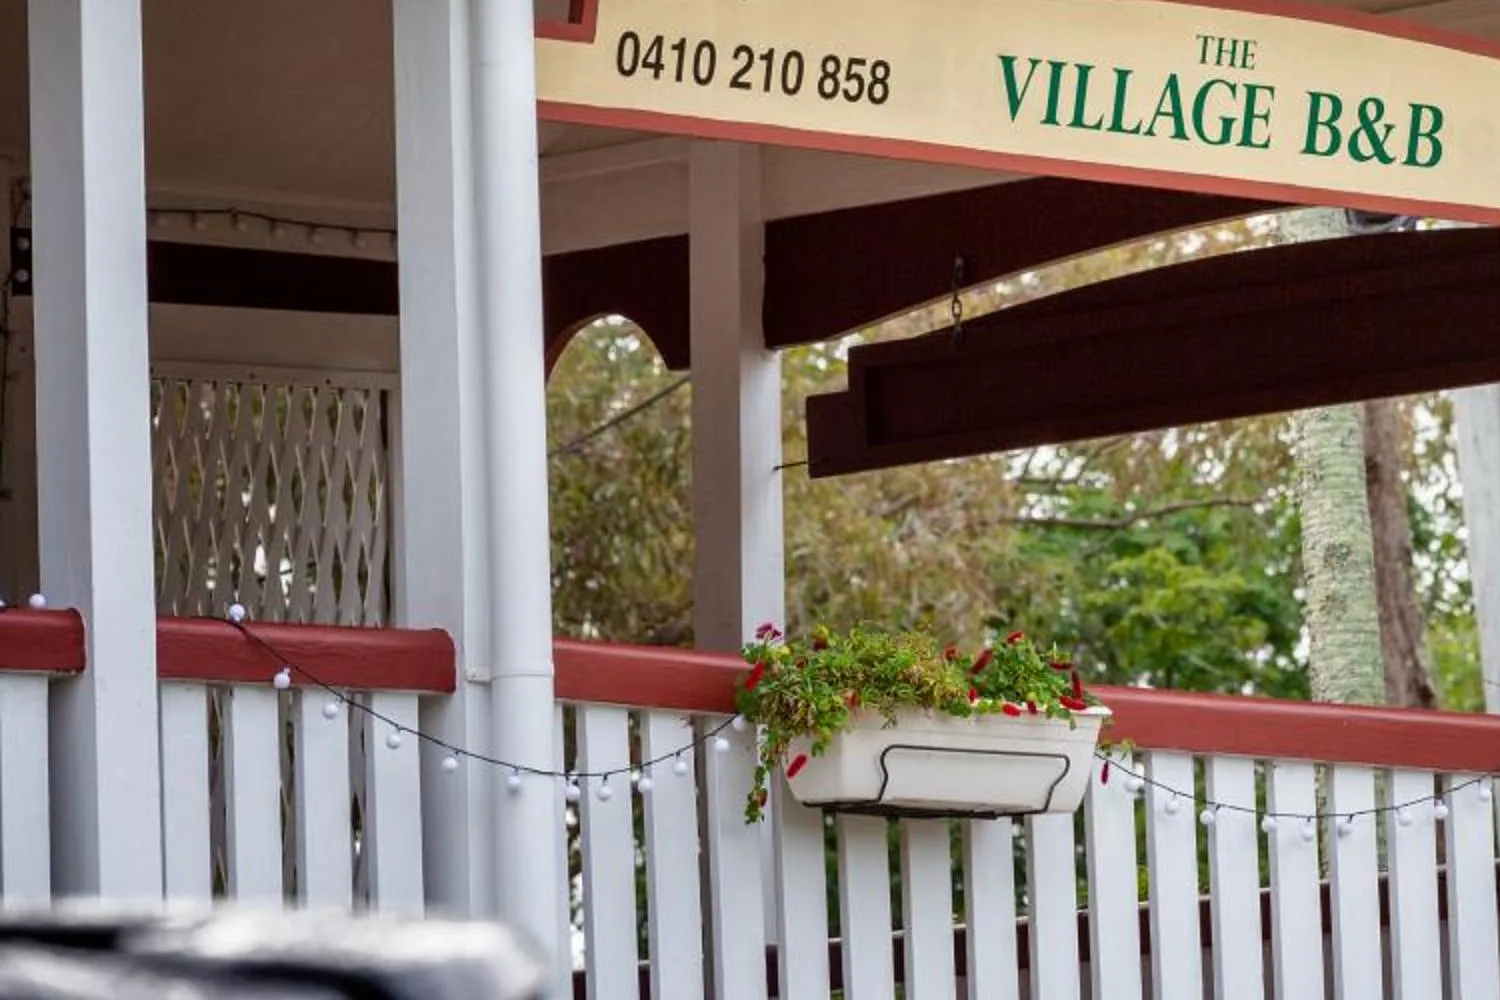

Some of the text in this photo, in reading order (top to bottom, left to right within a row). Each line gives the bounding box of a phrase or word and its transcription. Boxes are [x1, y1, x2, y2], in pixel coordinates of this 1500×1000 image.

[616, 30, 892, 106] 0410 210 858
[1195, 34, 1256, 70] THE
[996, 53, 1446, 170] VILLAGE B&B
